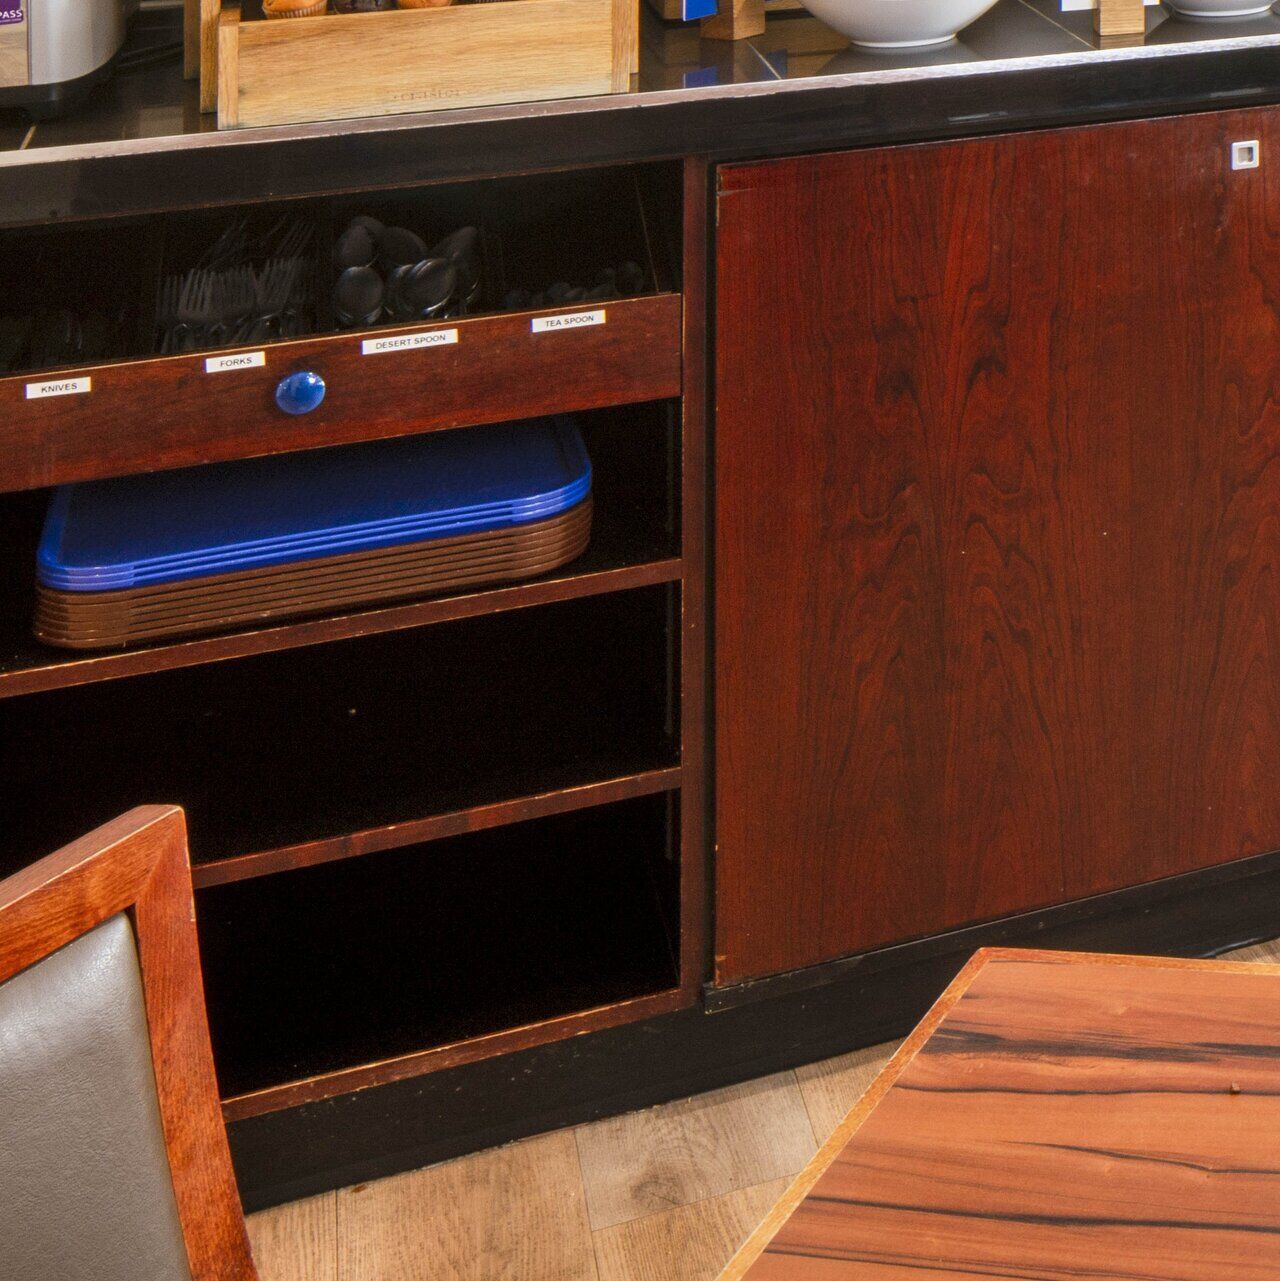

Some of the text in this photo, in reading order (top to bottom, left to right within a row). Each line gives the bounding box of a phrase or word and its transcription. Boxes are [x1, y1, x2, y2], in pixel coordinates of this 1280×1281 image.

[546, 315, 595, 328] TEA SPOON
[375, 334, 446, 350] DESERT SPOON
[219, 357, 252, 368] FORKS
[41, 382, 78, 394] KNIVES
